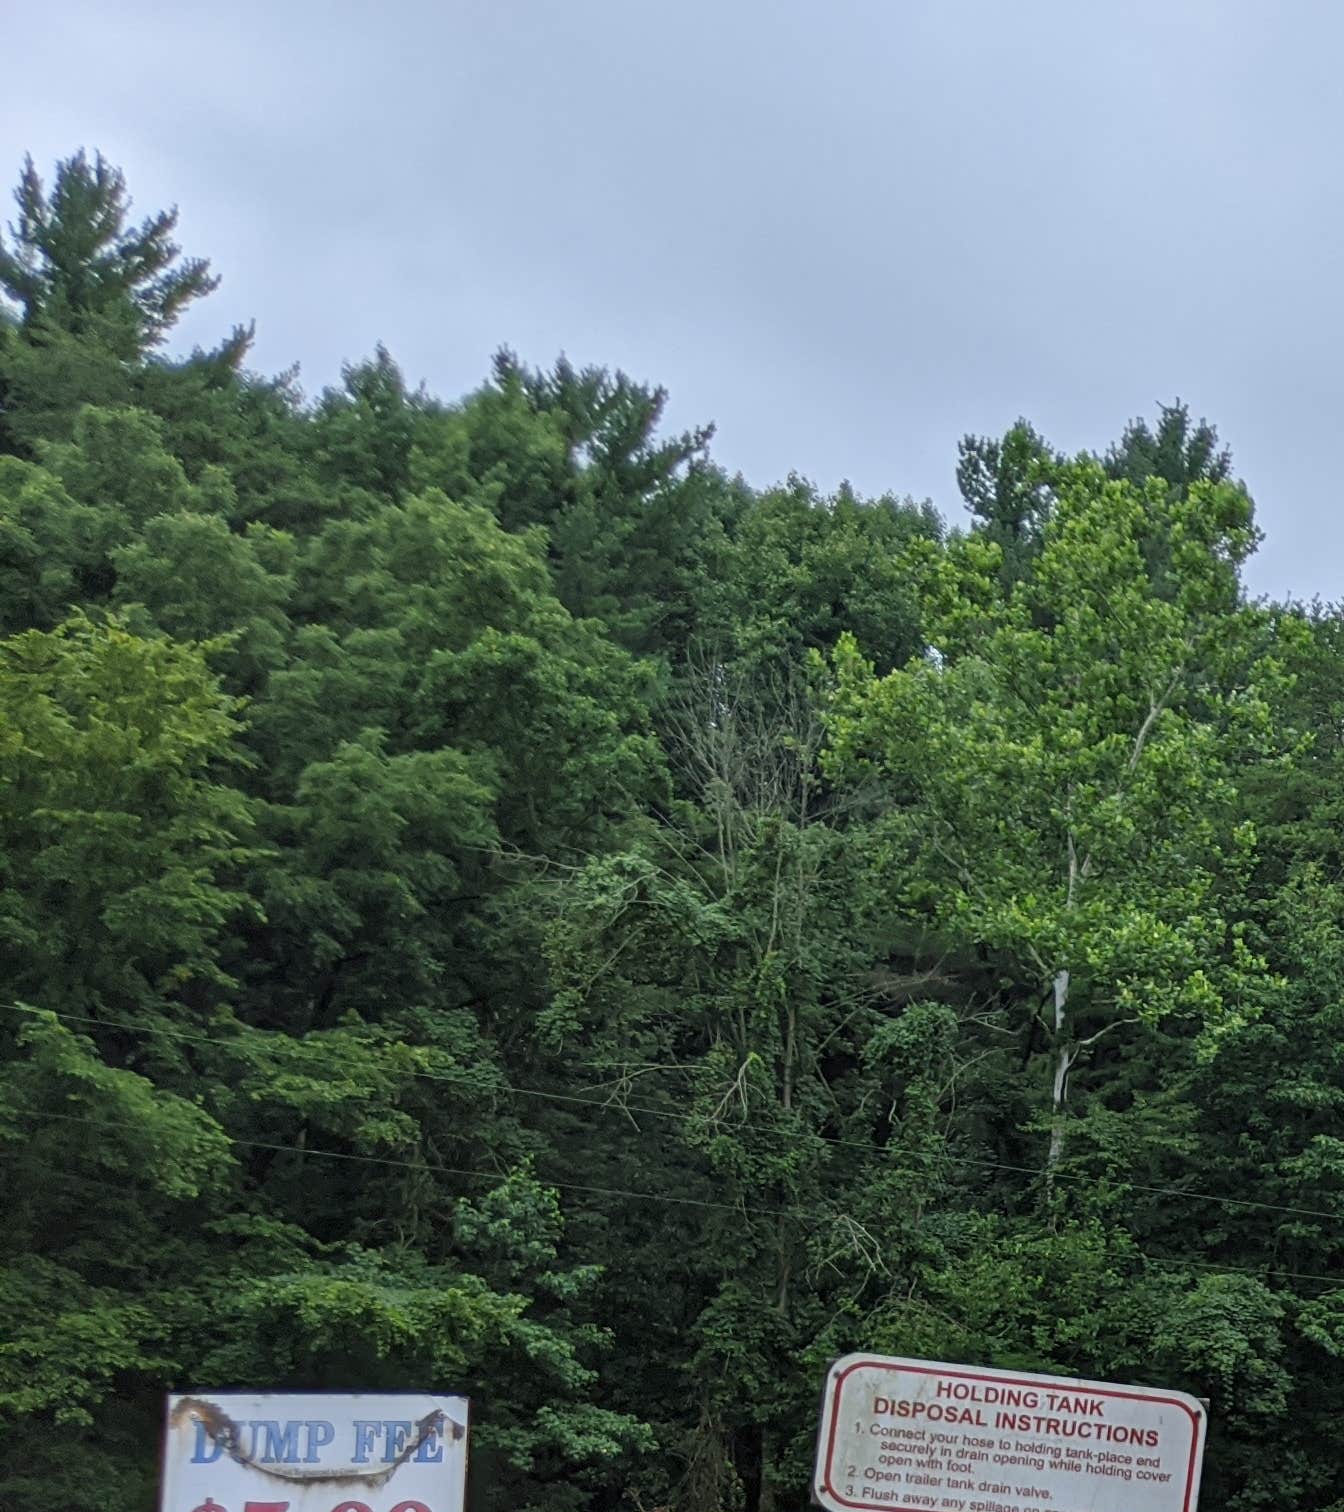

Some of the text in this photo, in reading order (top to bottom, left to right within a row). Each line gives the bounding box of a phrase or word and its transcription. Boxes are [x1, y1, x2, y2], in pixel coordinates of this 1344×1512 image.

[936, 1381, 1104, 1417] HOLDING TANK
[190, 1419, 444, 1464] DUMP FEE
[873, 1397, 1159, 1447] DISPOSAL INSTRUCTIONS
[855, 1422, 1161, 1469] 1. Connect your hose to holding tank-place end
[878, 1454, 975, 1474] open with foot.
[881, 1441, 1173, 1483] securely in drain opening while holding cover
[862, 1486, 899, 1502] Flush
[902, 1494, 939, 1508] away
[941, 1498, 966, 1510] any
[864, 1467, 902, 1482] Open
[905, 1471, 943, 1487] trailer
[947, 1475, 975, 1490] tank
[978, 1480, 1011, 1495] drain
[1015, 1486, 1053, 1500] valve.
